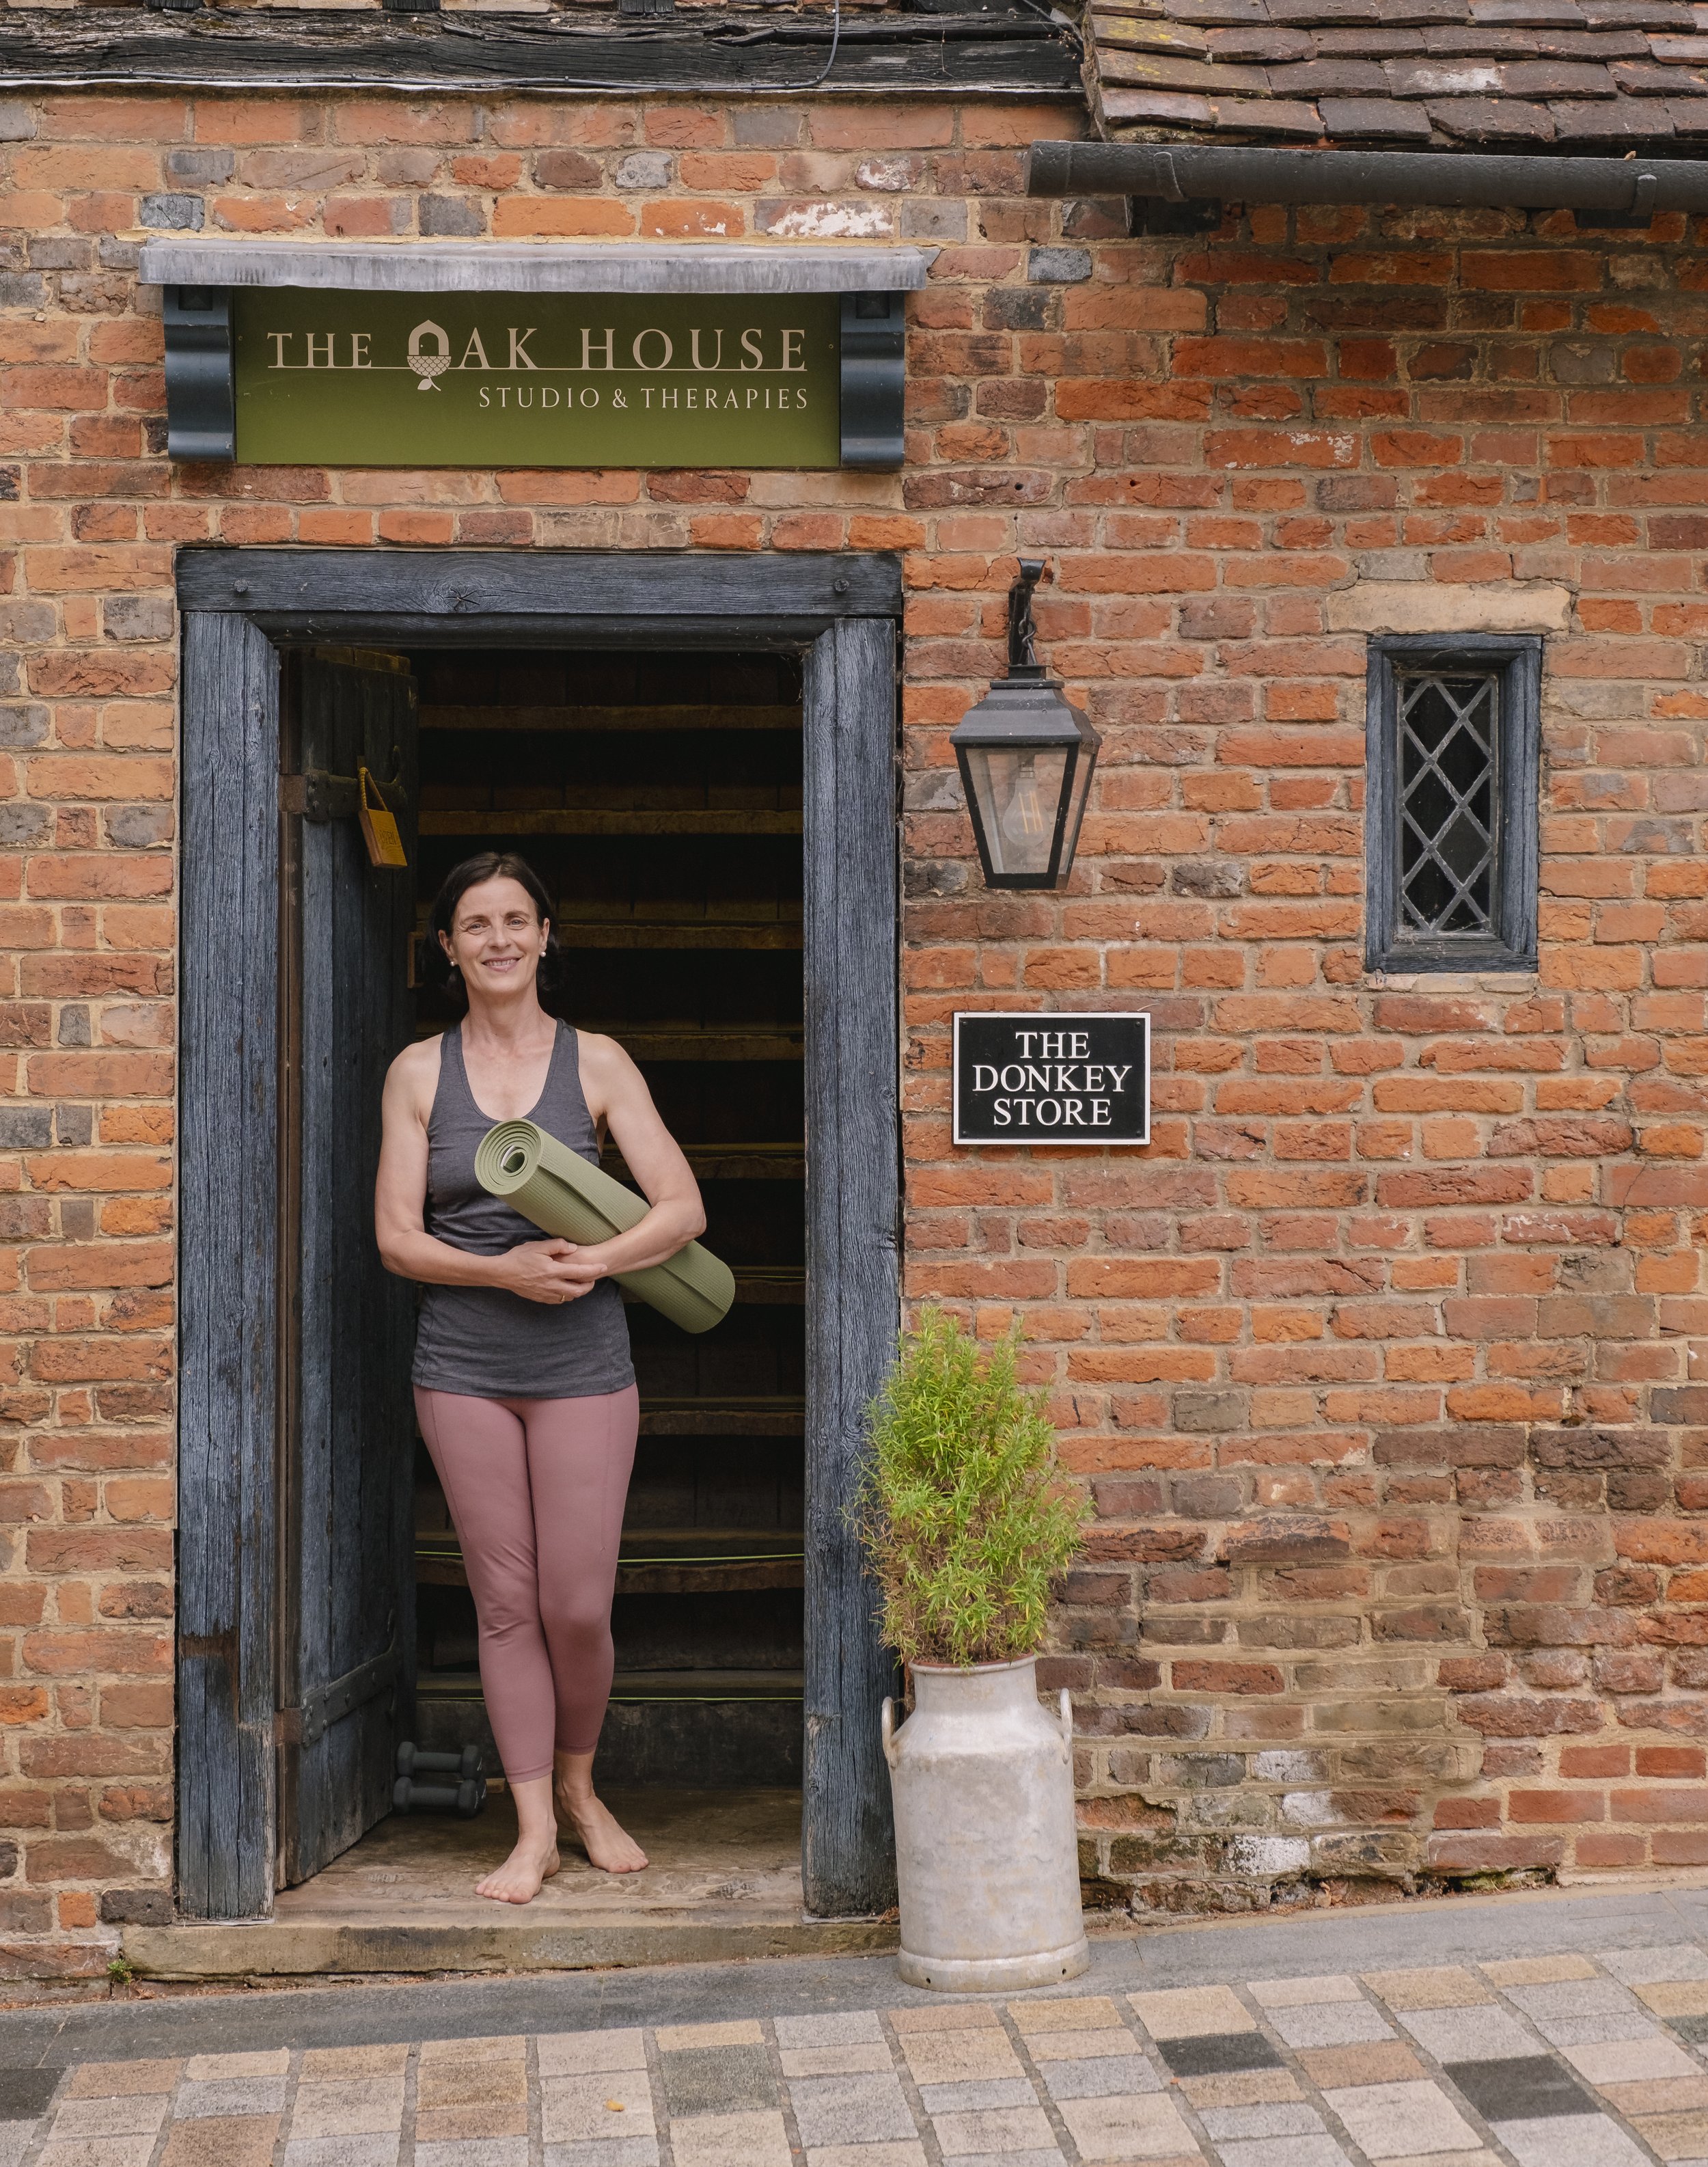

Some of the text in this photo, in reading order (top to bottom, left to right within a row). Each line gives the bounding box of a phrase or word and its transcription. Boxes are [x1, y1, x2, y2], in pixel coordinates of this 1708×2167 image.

[267, 332, 372, 368] THE
[579, 329, 808, 370] HOUSE
[479, 387, 808, 409] STUDIO & THERAPIES
[1015, 1031, 1090, 1059] THE
[972, 1064, 1133, 1093] DONKEY
[993, 1098, 1112, 1126] STORE
